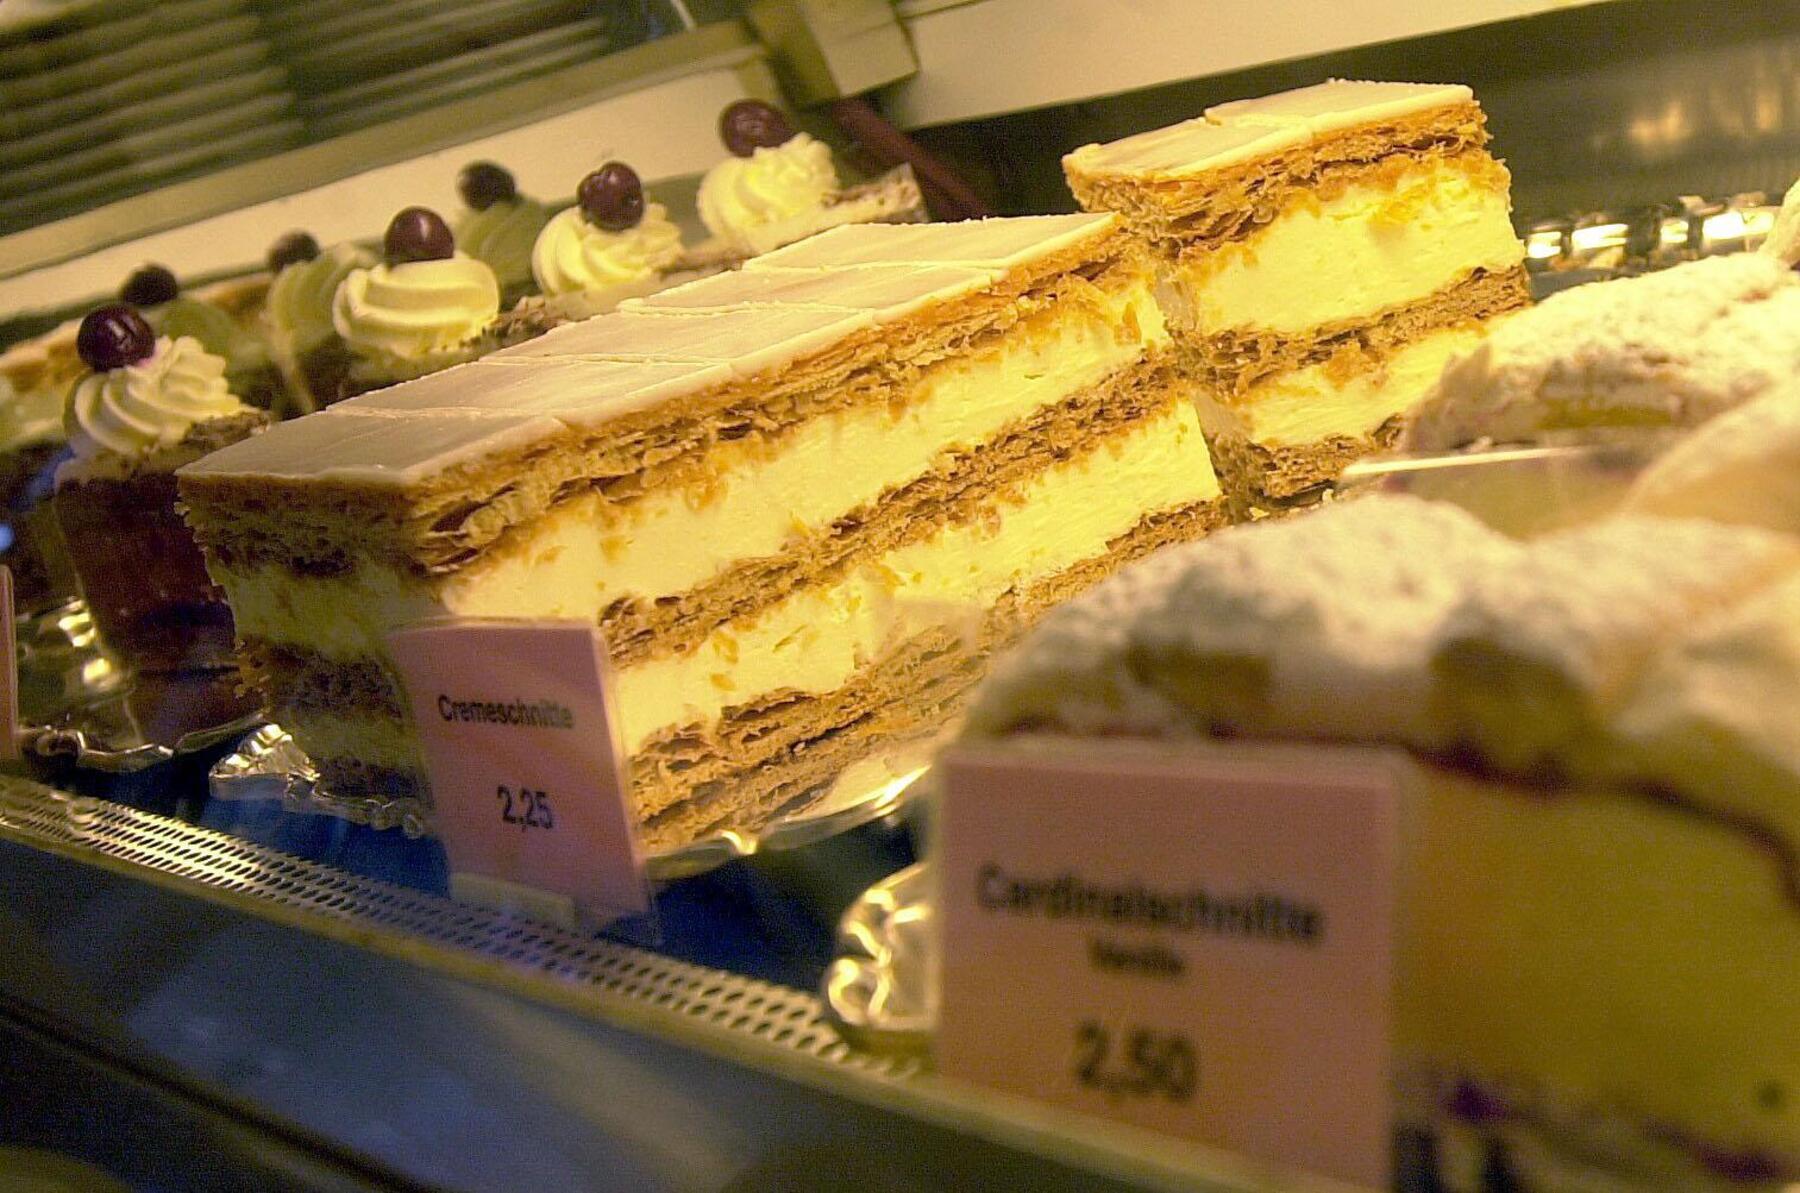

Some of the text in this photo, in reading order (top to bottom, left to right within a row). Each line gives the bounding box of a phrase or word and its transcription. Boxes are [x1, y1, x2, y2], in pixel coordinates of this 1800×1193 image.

[438, 694, 573, 729] Cremeschnitte
[496, 784, 554, 833] 2,25
[975, 861, 1325, 945] Cardinalschnitte
